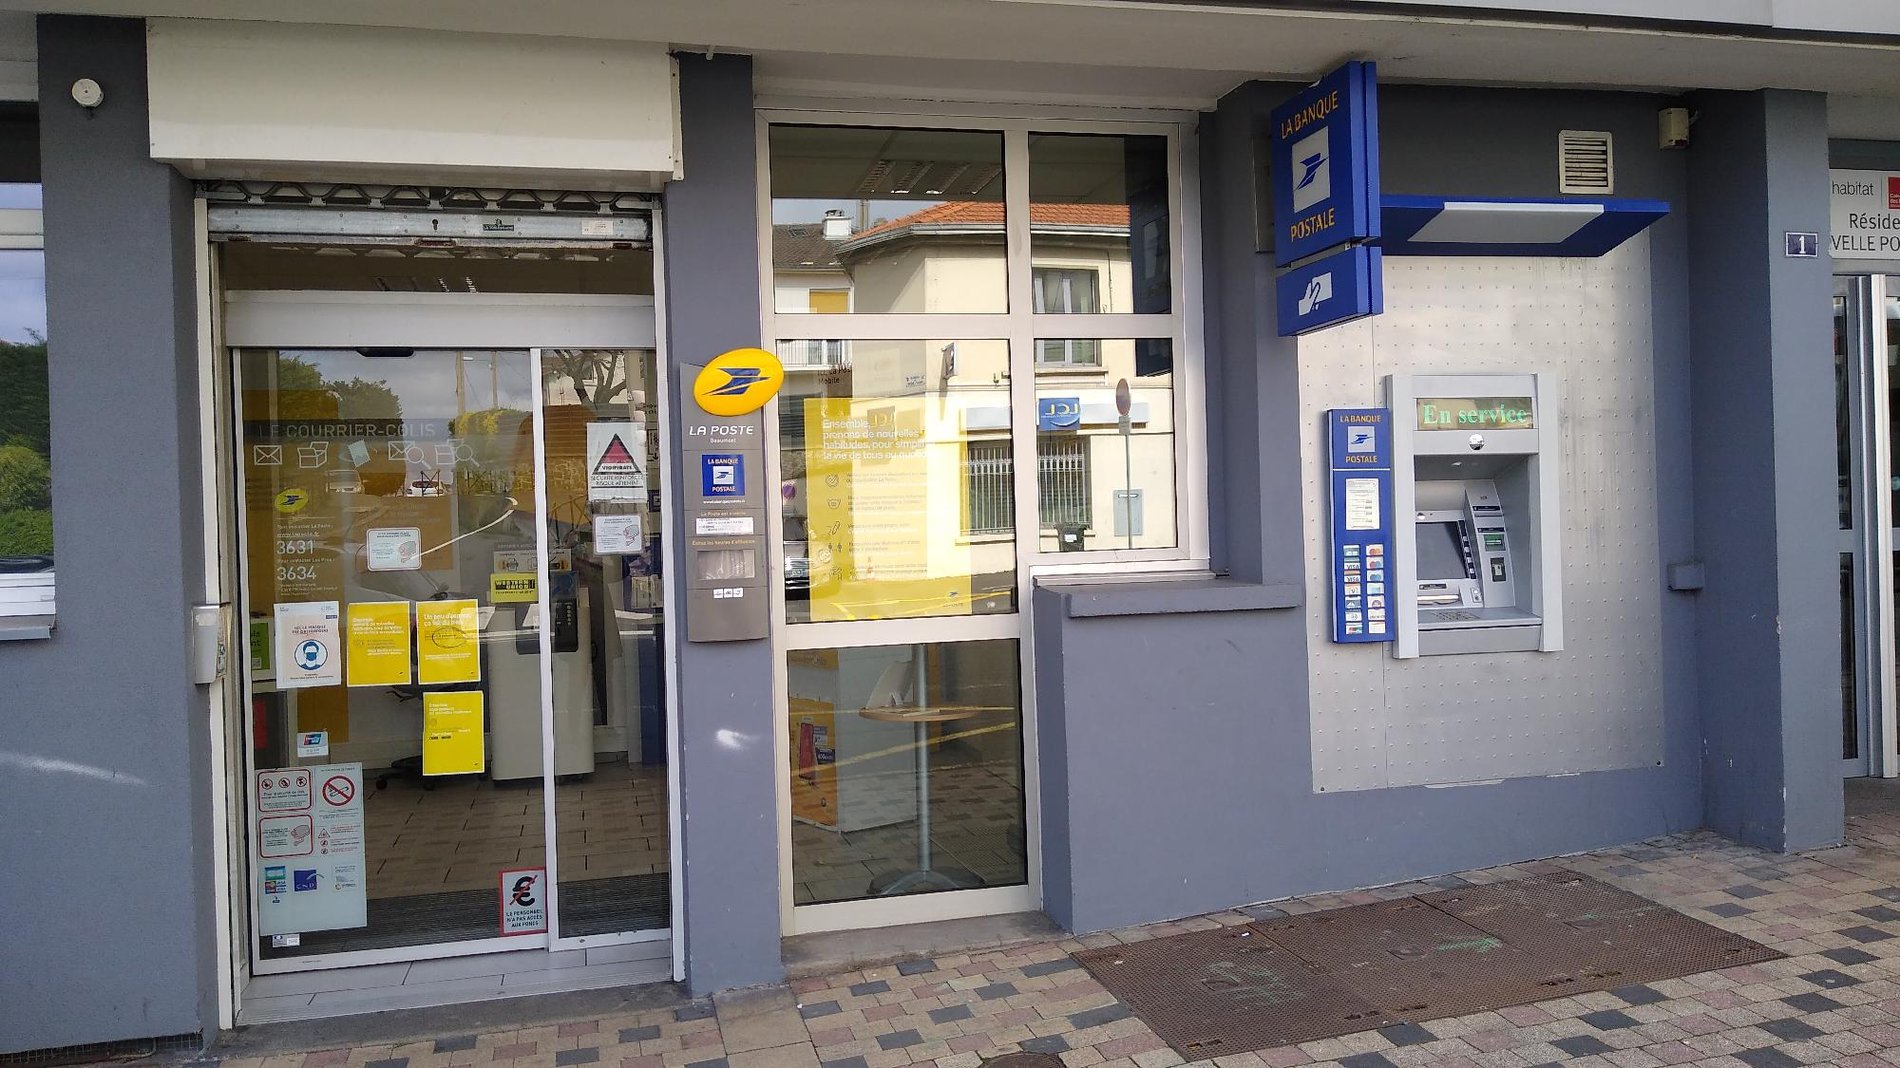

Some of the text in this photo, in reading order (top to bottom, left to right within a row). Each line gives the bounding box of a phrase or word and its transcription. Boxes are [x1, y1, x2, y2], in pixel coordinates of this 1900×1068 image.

[1281, 90, 1338, 139] LA BANQUE
[1831, 180, 1874, 196] habitat
[1290, 208, 1335, 242] POSTALE
[1849, 212, 1900, 230] Réside
[1799, 235, 1806, 254] 1
[1831, 235, 1875, 251] VELLE
[1350, 414, 1381, 423] BANQUE
[1423, 403, 1527, 424] En service
[286, 423, 436, 438] COURRIER-COLIS
[689, 425, 754, 436] LA POSTE
[823, 419, 871, 429] Ensemble,
[864, 429, 875, 438] de
[876, 428, 919, 438] nouvelles
[872, 441, 893, 450] pour
[1345, 455, 1378, 464] POSTALE
[276, 540, 314, 554] 3631
[276, 566, 317, 580] 3634
